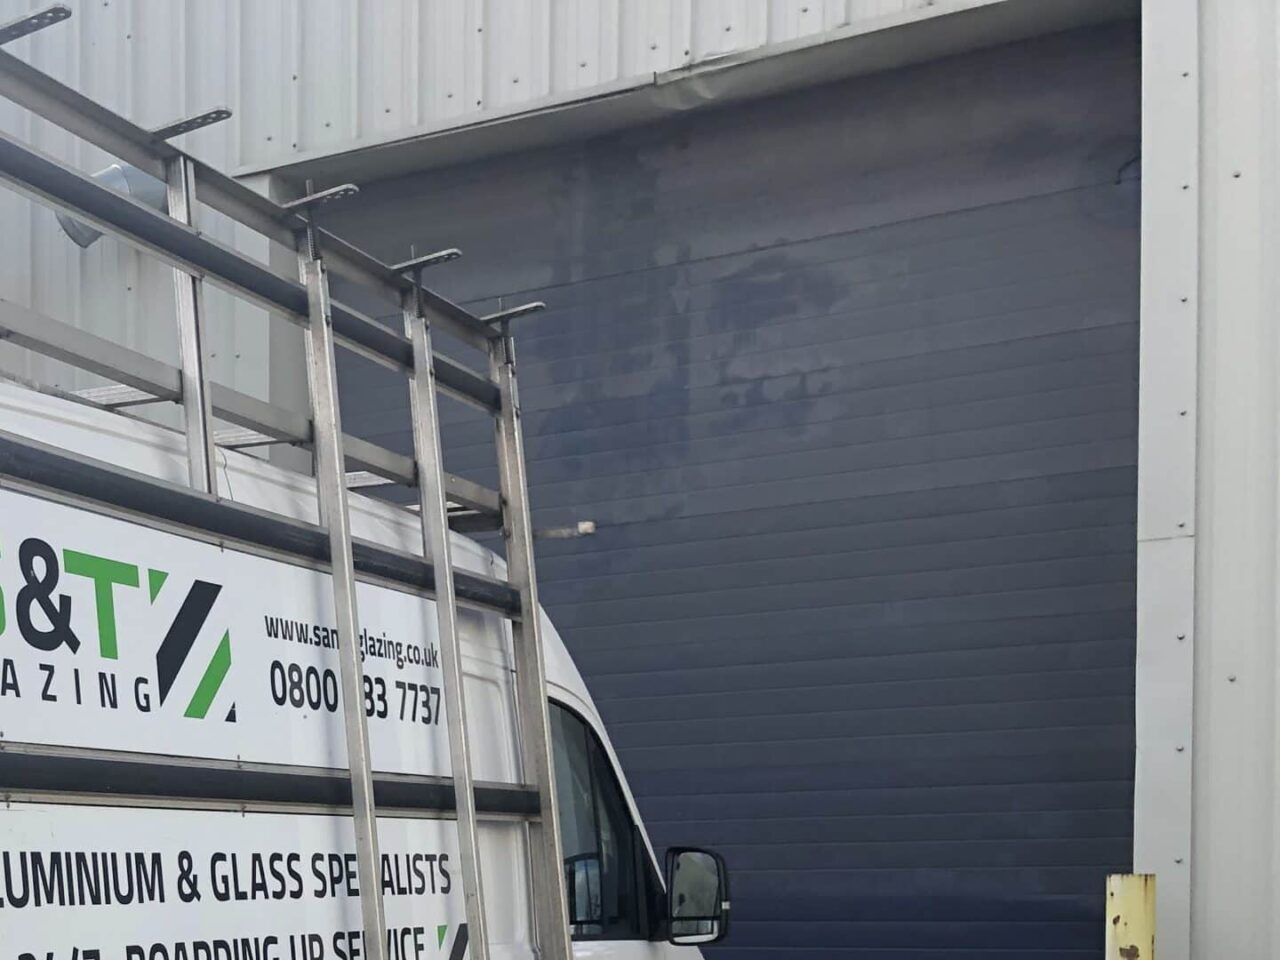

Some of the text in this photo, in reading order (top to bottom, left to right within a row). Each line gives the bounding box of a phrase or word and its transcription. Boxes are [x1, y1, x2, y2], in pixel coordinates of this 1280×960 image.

[263, 615, 439, 669] www.sanlazing.co.uk
[270, 660, 338, 713] 0800
[395, 680, 441, 726] 7737
[177, 851, 202, 902] &
[210, 852, 304, 902] GLASS
[311, 852, 451, 899] SPEALISTS
